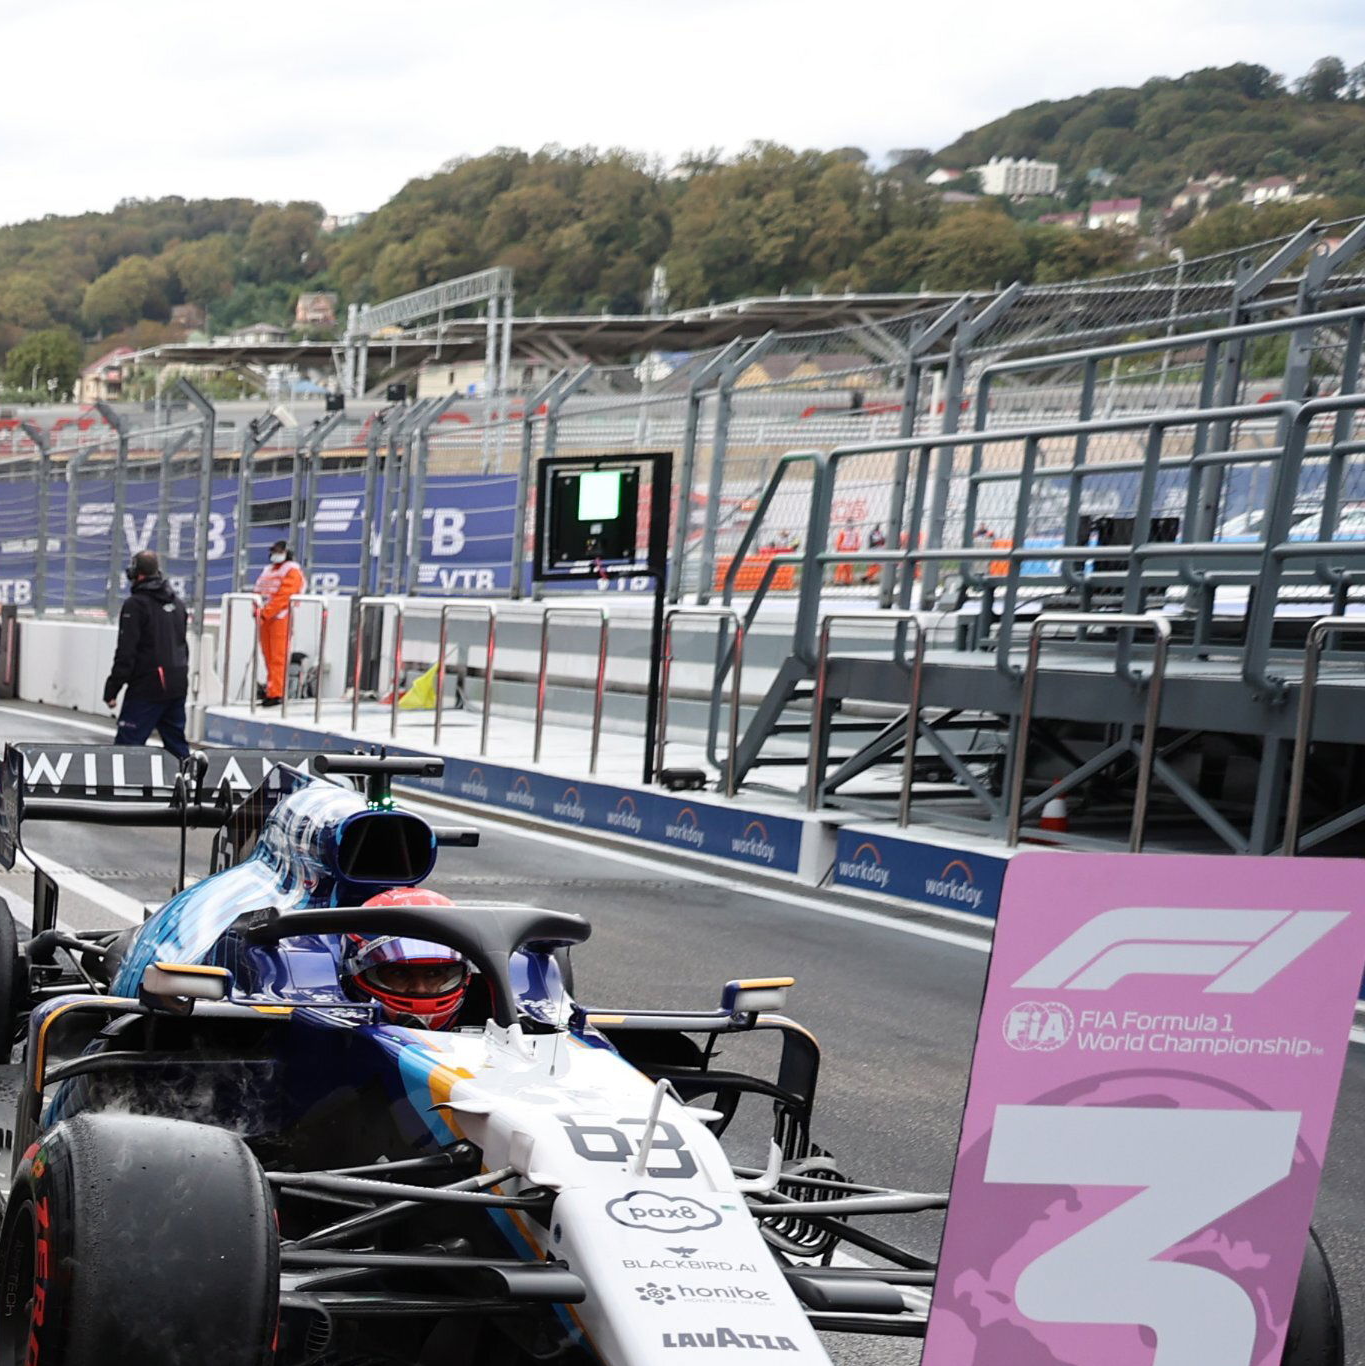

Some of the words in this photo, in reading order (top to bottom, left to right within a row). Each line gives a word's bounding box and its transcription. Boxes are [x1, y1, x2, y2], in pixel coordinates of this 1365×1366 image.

[439, 569, 495, 594] VTB
[607, 808, 642, 833] workday
[665, 820, 704, 848] workday
[731, 837, 775, 863] workday
[838, 857, 890, 888] workday
[925, 874, 982, 909] workday
[1080, 1010, 1118, 1031] FIA
[1122, 1011, 1218, 1032] Formula
[1220, 1013, 1234, 1033] 1
[1077, 1031, 1144, 1052] World
[629, 1203, 698, 1224] pax8
[622, 1258, 758, 1273] BLACKBIRD.AI
[678, 1283, 771, 1302] honibe
[662, 1327, 800, 1352] LAVAZZA
